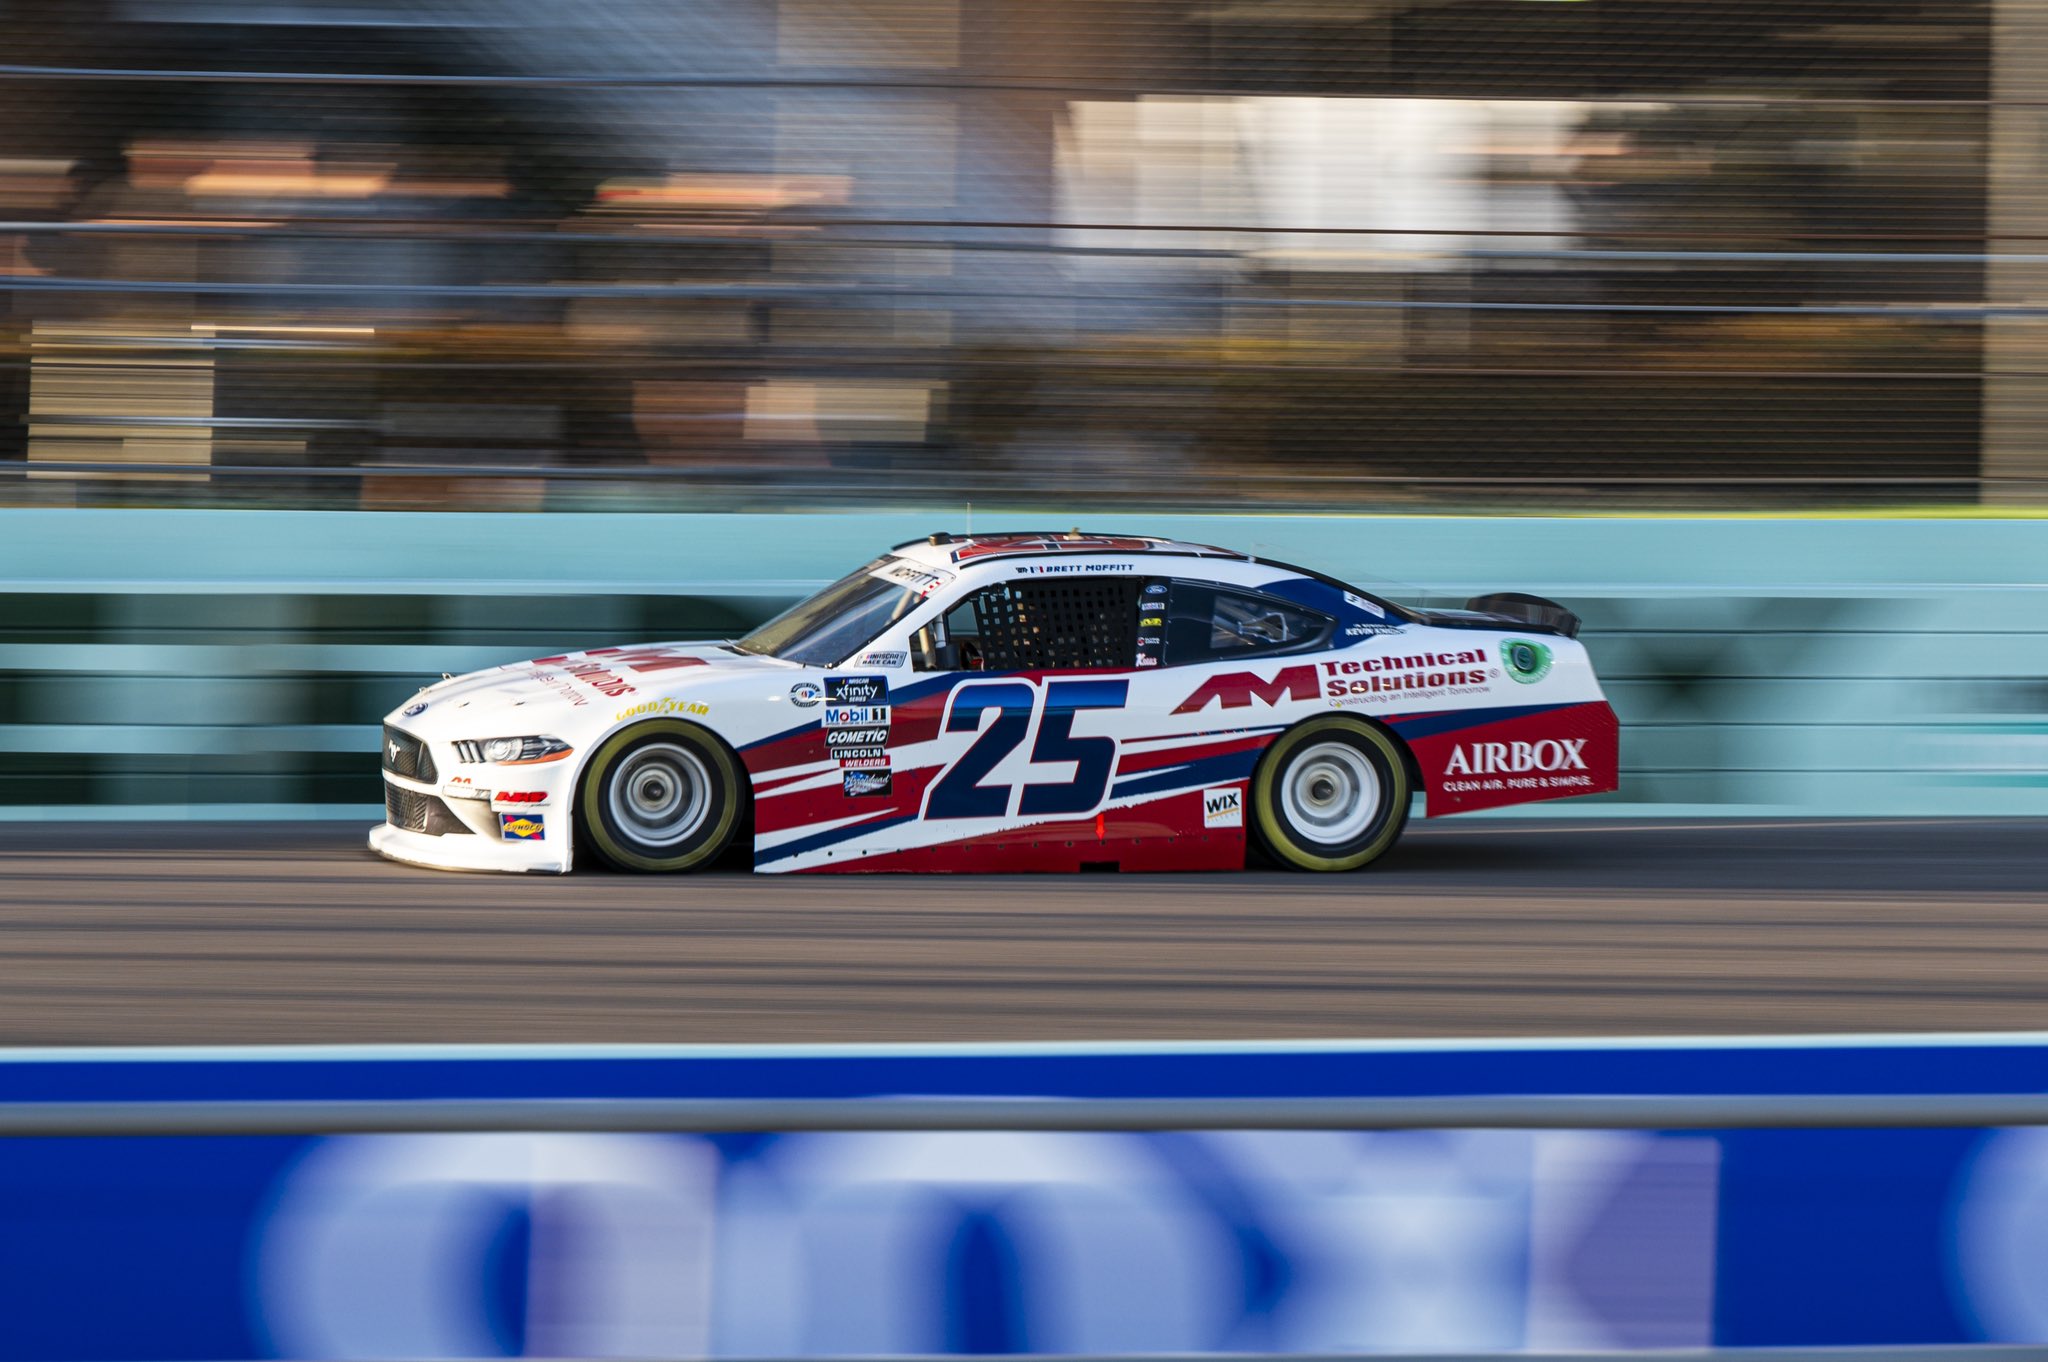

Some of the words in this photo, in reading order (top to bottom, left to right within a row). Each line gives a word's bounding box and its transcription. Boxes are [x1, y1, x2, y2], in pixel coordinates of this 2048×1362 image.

[1046, 564, 1082, 573] BRETT
[1085, 563, 1134, 572] MOFFITT
[1345, 627, 1374, 636] KEVIN
[1319, 648, 1488, 677] Technical
[1170, 663, 1322, 716] AM
[1326, 668, 1487, 697] Solutions
[836, 684, 878, 700] xfinity
[826, 708, 868, 722] Mobil
[872, 708, 886, 720] 1
[827, 729, 888, 744] COMETIC
[834, 749, 881, 759] LINCOLN
[922, 678, 1130, 821] 25
[1443, 738, 1590, 776] AIRBOX
[845, 758, 887, 767] WELDERS
[1442, 780, 1481, 793] CLEAN
[1482, 779, 1507, 791] AIR.
[1507, 777, 1539, 789] PURE
[1539, 777, 1549, 788] &
[1549, 775, 1595, 788] SIMPLE.
[1206, 792, 1240, 814] WIX
[503, 822, 545, 833] SUNOCO
